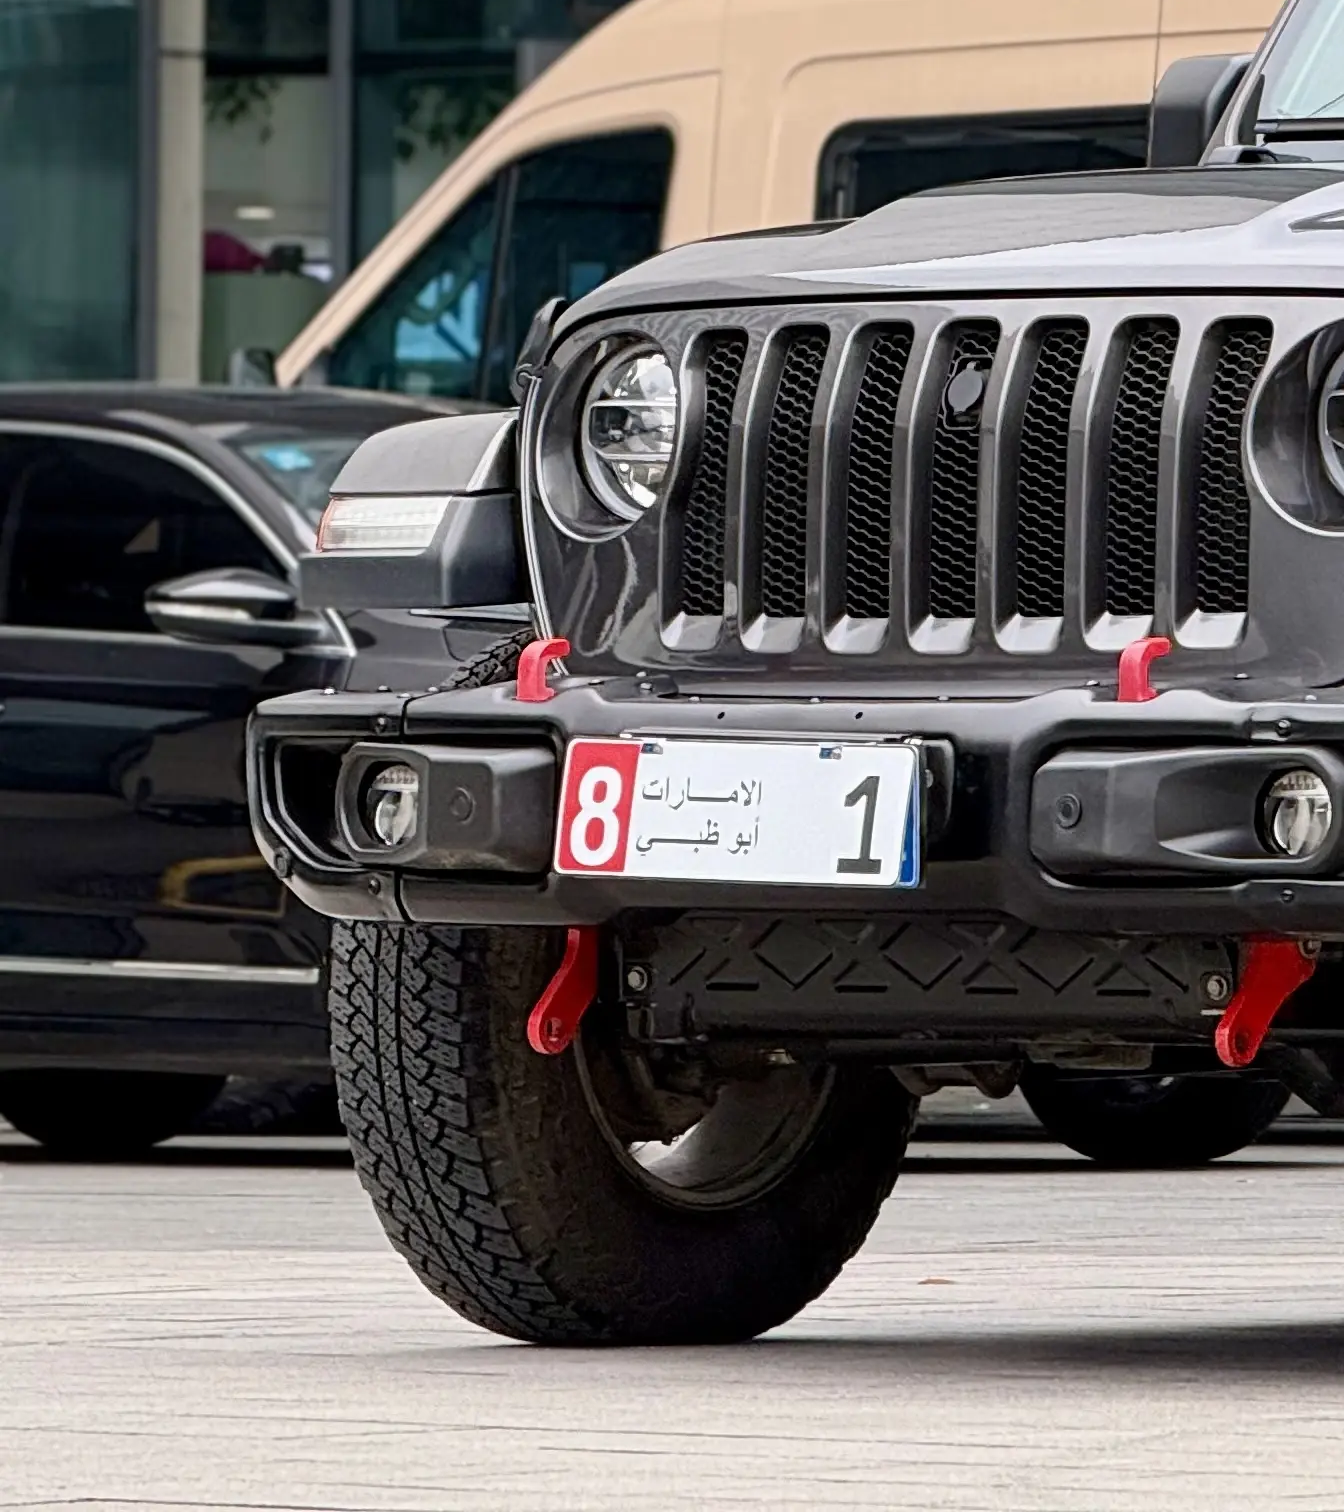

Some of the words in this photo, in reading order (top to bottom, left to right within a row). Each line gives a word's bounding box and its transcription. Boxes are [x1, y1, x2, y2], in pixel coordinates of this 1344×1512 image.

[569, 765, 623, 866] 8
[635, 818, 720, 857] ظبي
[836, 774, 883, 875] 1
